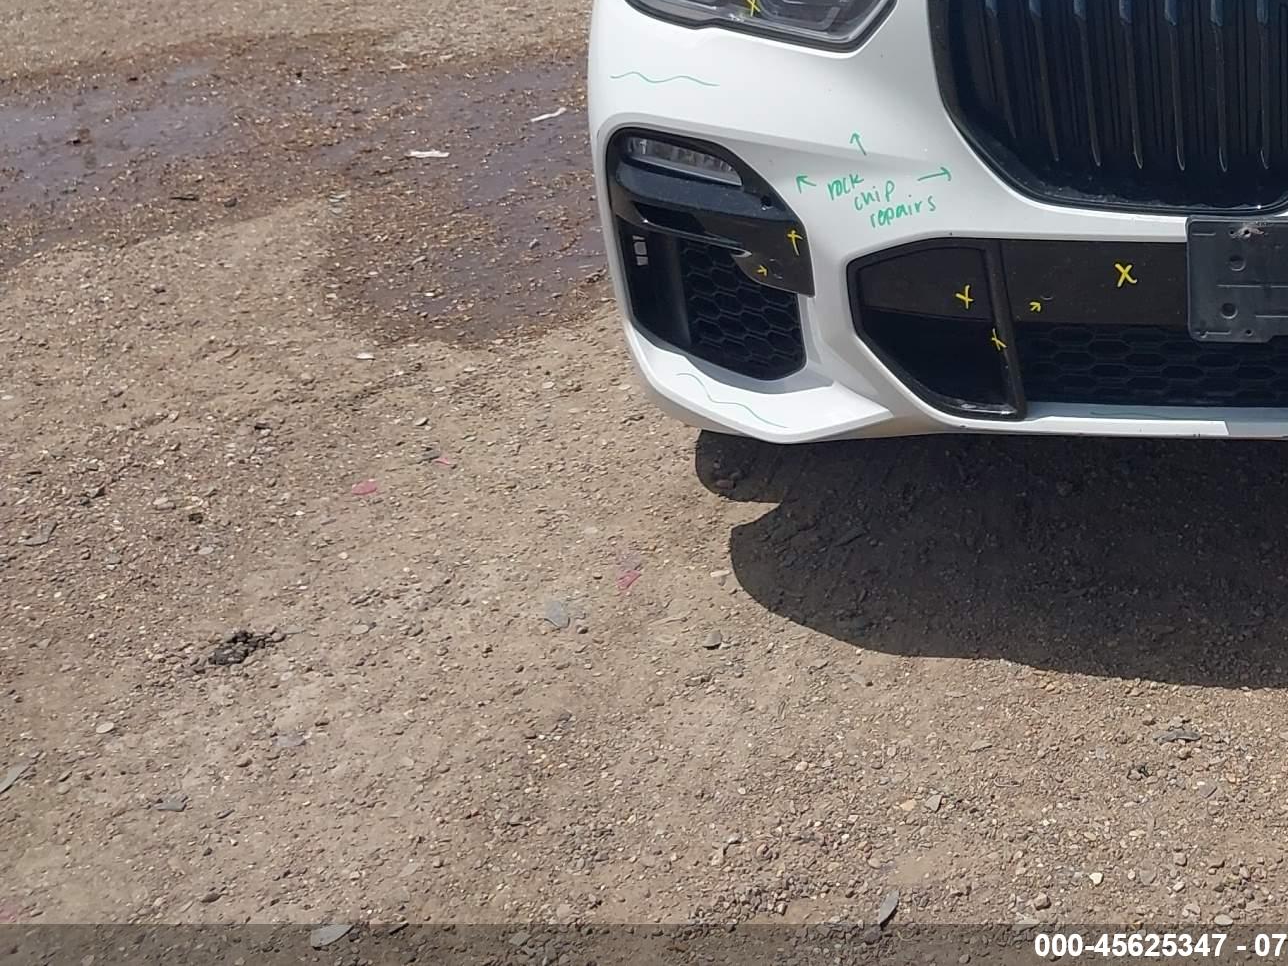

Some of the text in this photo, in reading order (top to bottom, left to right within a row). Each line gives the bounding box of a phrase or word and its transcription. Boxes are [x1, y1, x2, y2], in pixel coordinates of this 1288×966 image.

[827, 173, 865, 201] rock
[853, 179, 896, 211] chip
[869, 194, 937, 228] repairs
